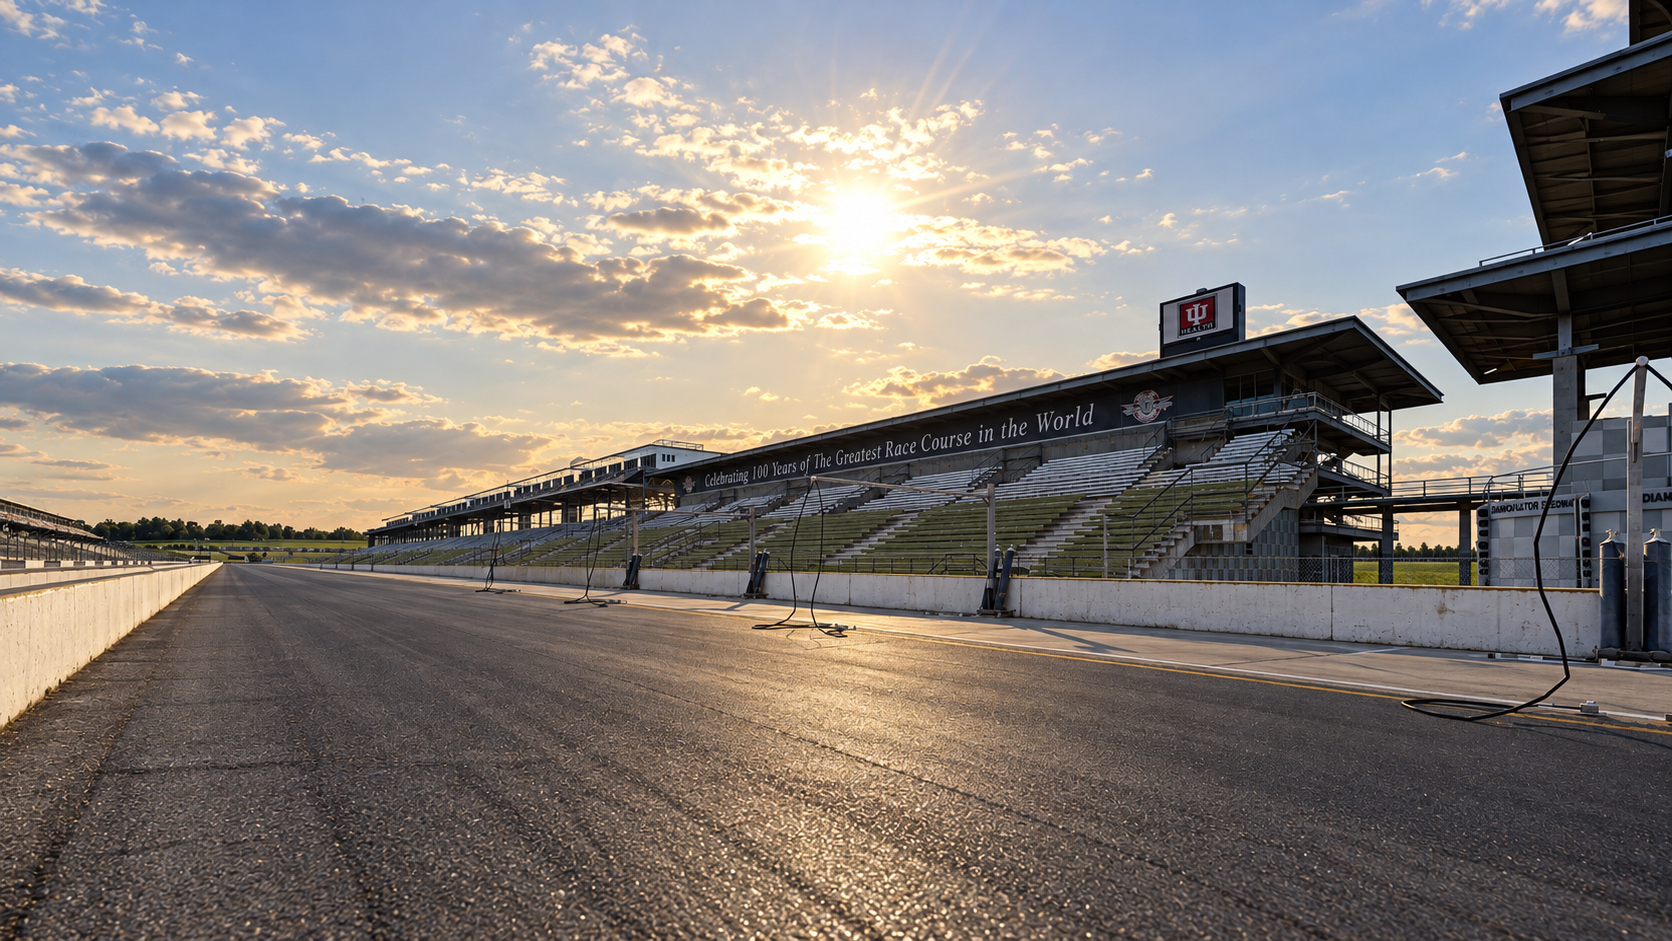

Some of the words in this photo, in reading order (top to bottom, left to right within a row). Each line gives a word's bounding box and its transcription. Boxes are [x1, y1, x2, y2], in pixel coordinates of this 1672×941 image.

[704, 469, 749, 487] Celebrating
[752, 464, 769, 480] 100
[772, 461, 797, 476] Years
[800, 454, 811, 477] of
[814, 453, 832, 469] The
[836, 445, 882, 466] Greatest
[885, 440, 917, 458] Race
[921, 433, 972, 452] Course
[979, 424, 994, 443] in
[1001, 417, 1028, 439] the
[1036, 403, 1094, 433] World
